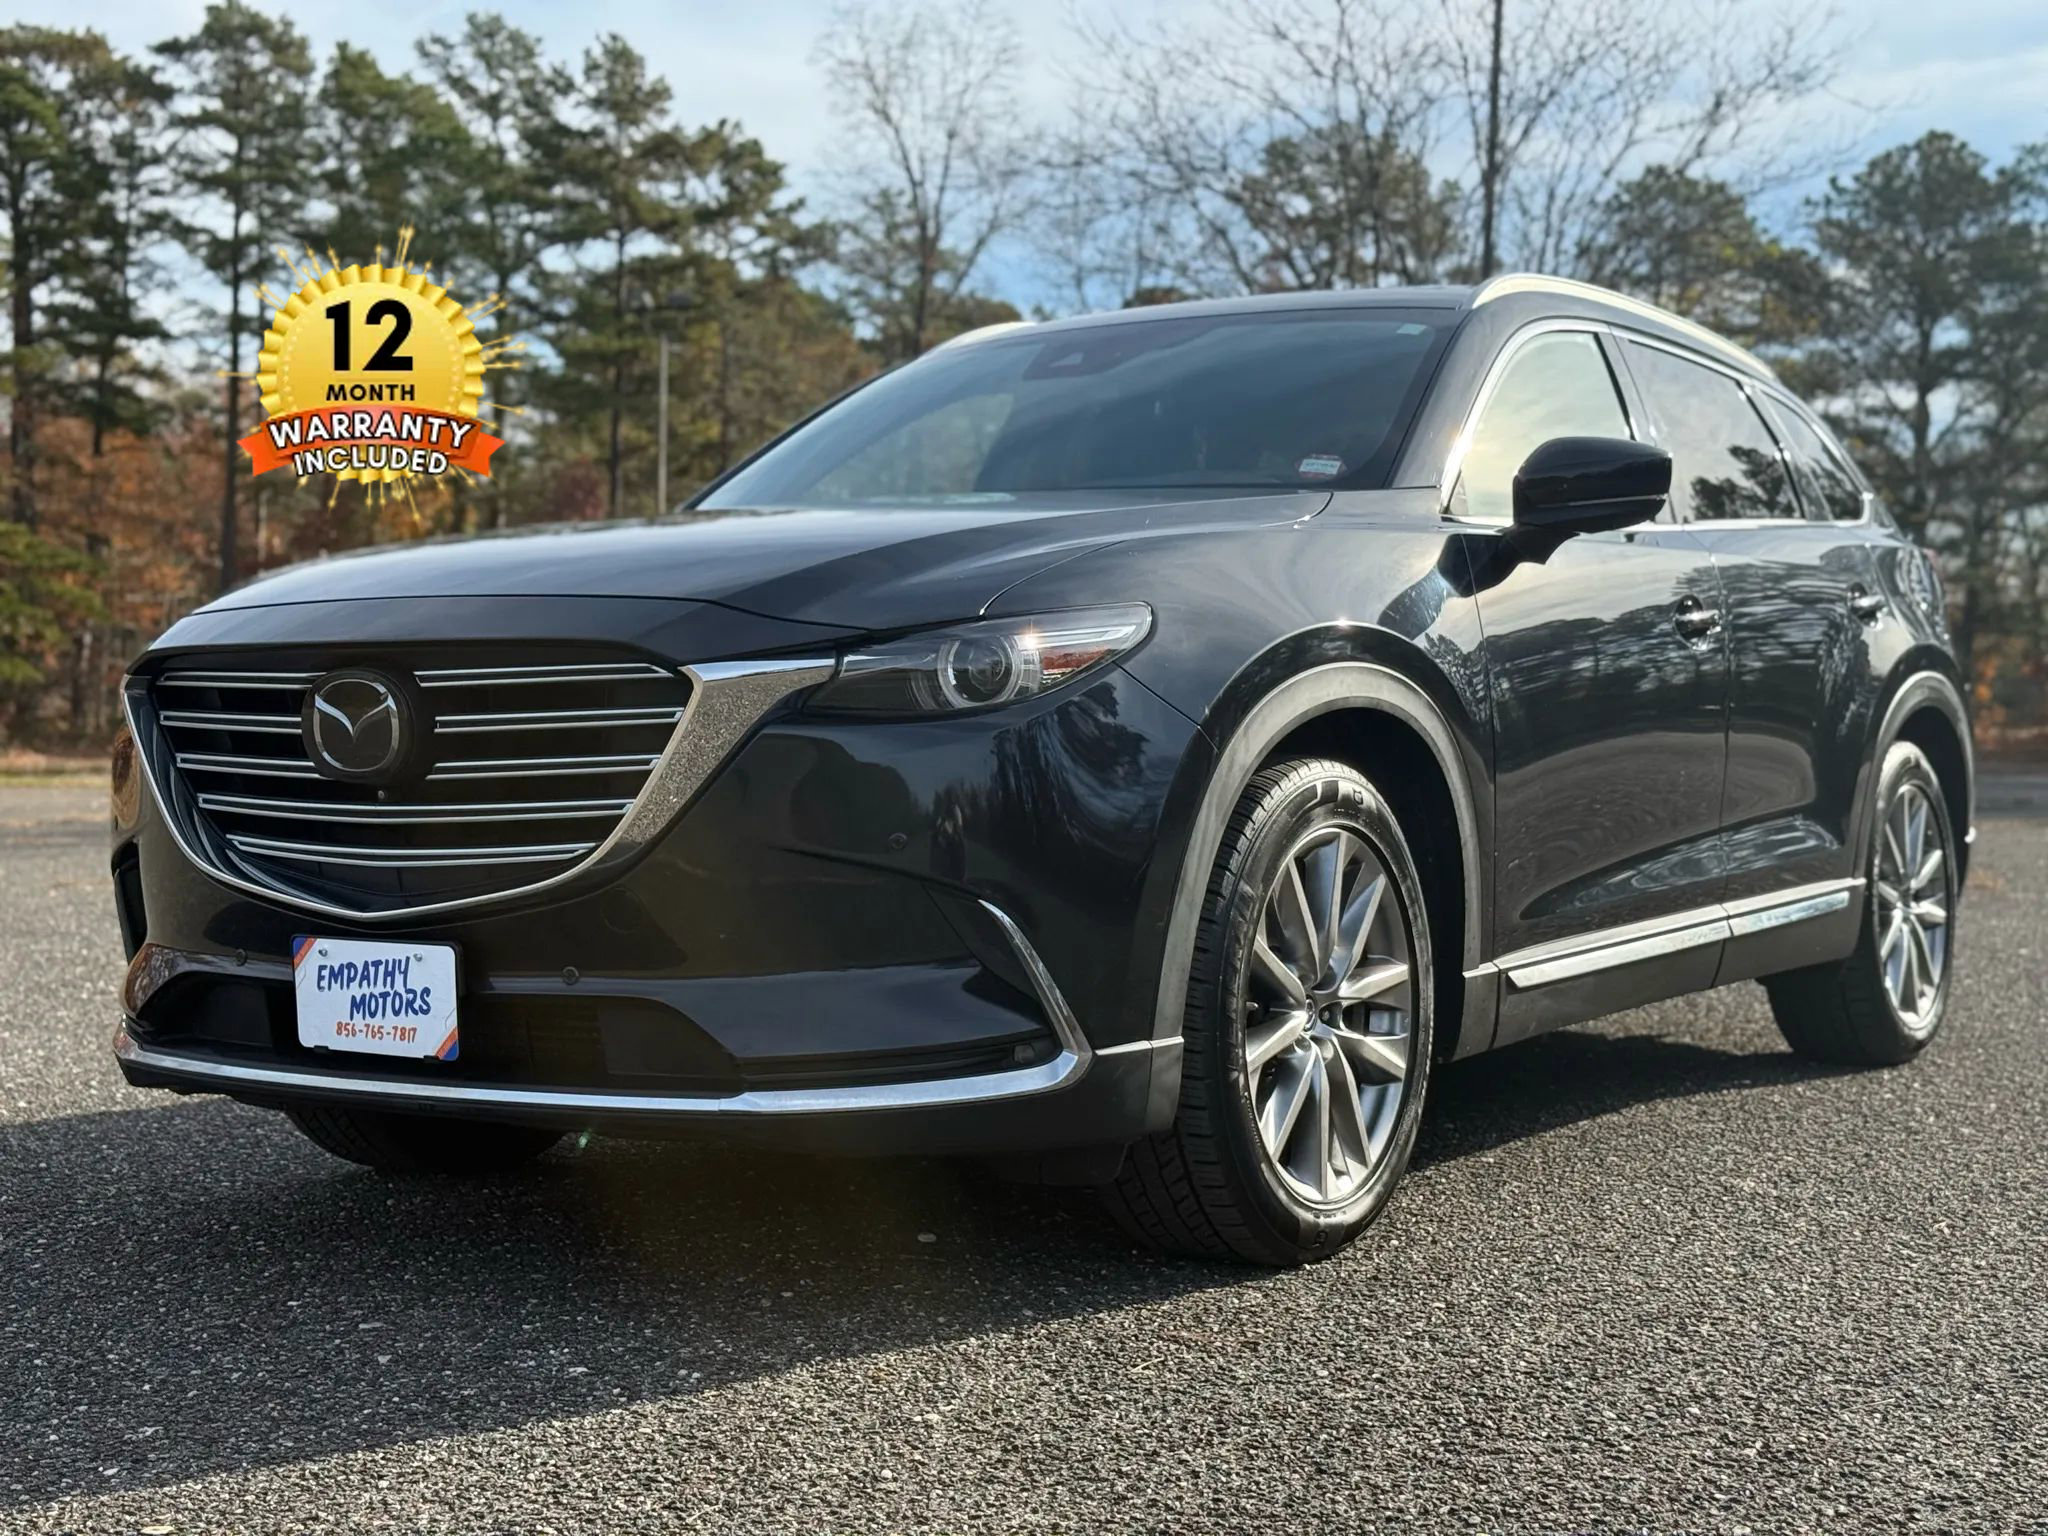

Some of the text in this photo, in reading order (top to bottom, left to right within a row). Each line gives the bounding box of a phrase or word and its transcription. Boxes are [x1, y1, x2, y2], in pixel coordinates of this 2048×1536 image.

[316, 956, 411, 992] EMPATHY
[350, 986, 432, 1021] MOTORS
[336, 1021, 418, 1044] 856-765-7817
